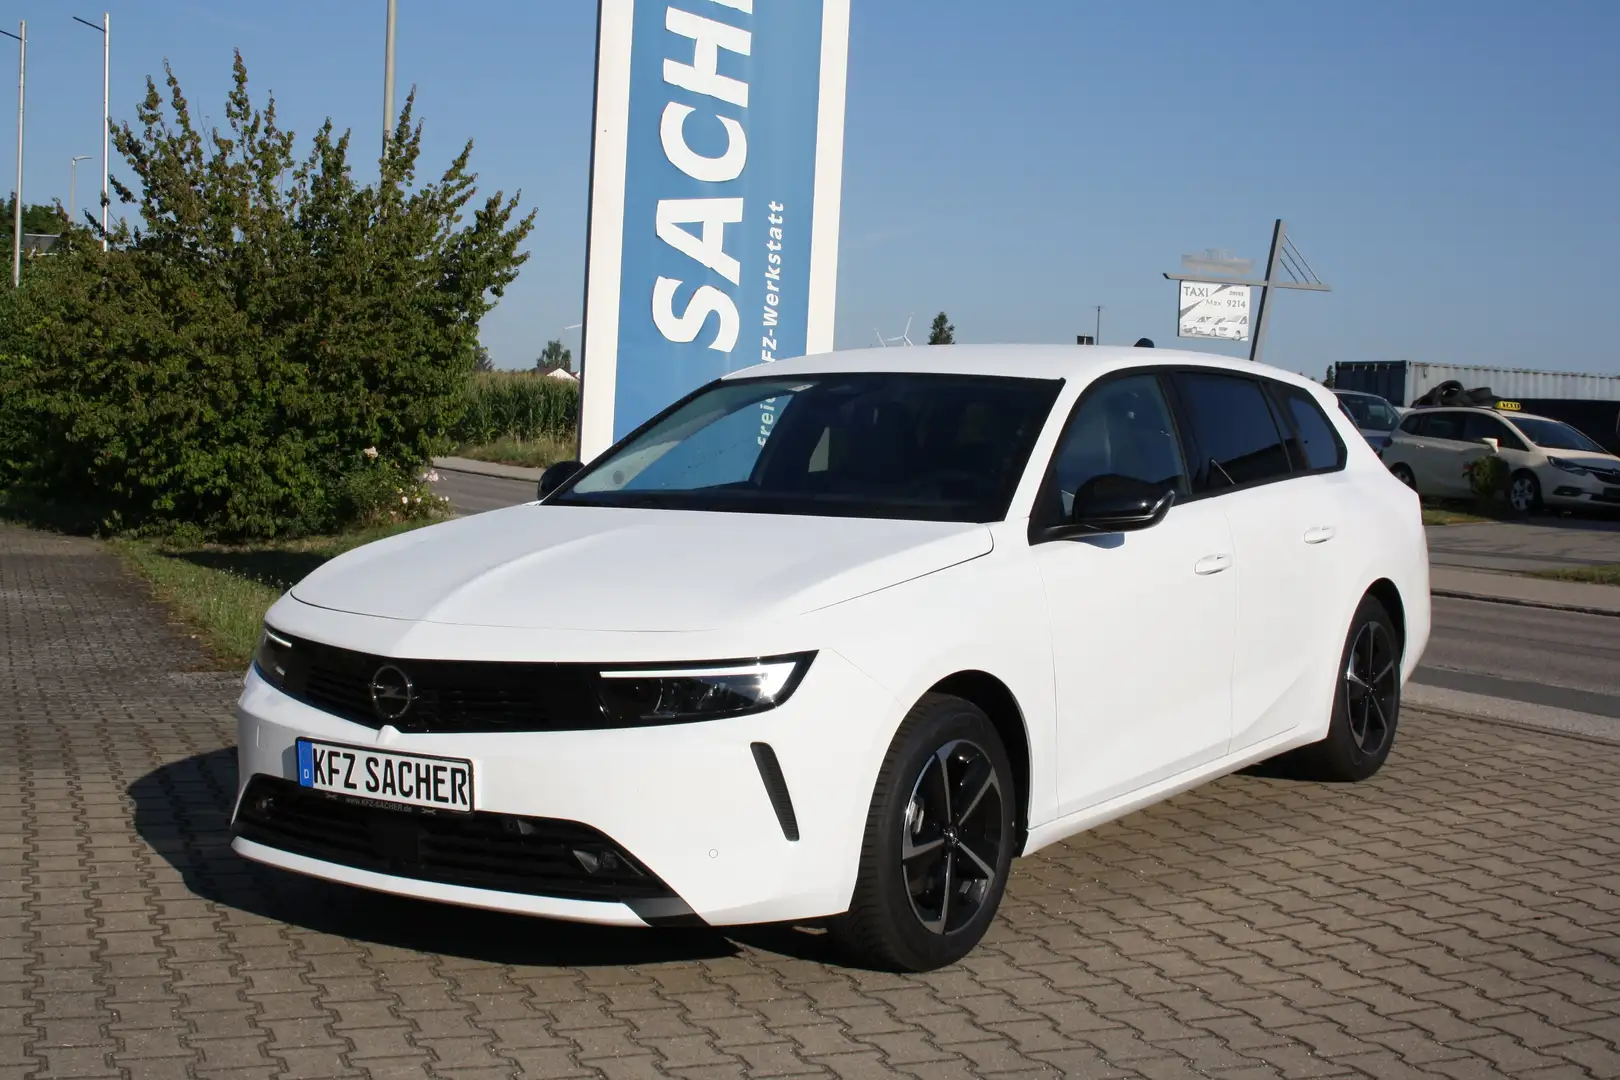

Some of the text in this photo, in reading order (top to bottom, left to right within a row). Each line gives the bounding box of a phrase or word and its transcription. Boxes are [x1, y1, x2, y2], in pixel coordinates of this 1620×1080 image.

[652, 0, 753, 352] SACH
[761, 201, 784, 363] FZ-Werkstatt
[1183, 286, 1209, 298] TAXI
[1226, 300, 1246, 308] 9214
[304, 768, 310, 779] D
[313, 748, 468, 805] KFZ SACHER
[345, 798, 413, 812] www.KFZ-SACHER.de
